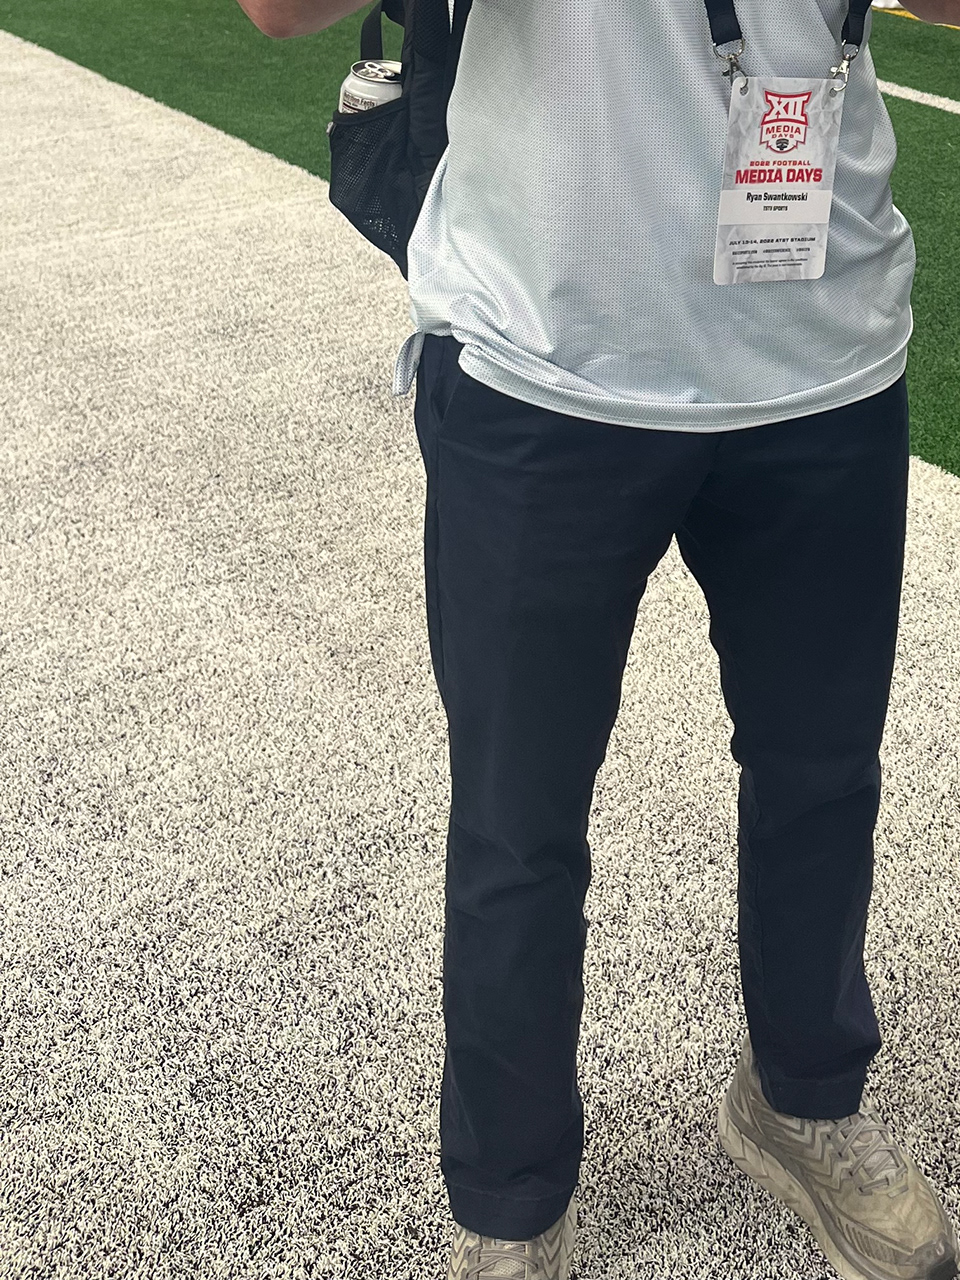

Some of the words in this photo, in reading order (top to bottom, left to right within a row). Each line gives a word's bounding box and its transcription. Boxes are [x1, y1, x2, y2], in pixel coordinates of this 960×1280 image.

[765, 125, 801, 135] MEDIA
[735, 169, 783, 184] MEDIA
[786, 168, 823, 183] DAYS
[746, 192, 762, 203] Ryan
[763, 192, 808, 201] Swantkowski
